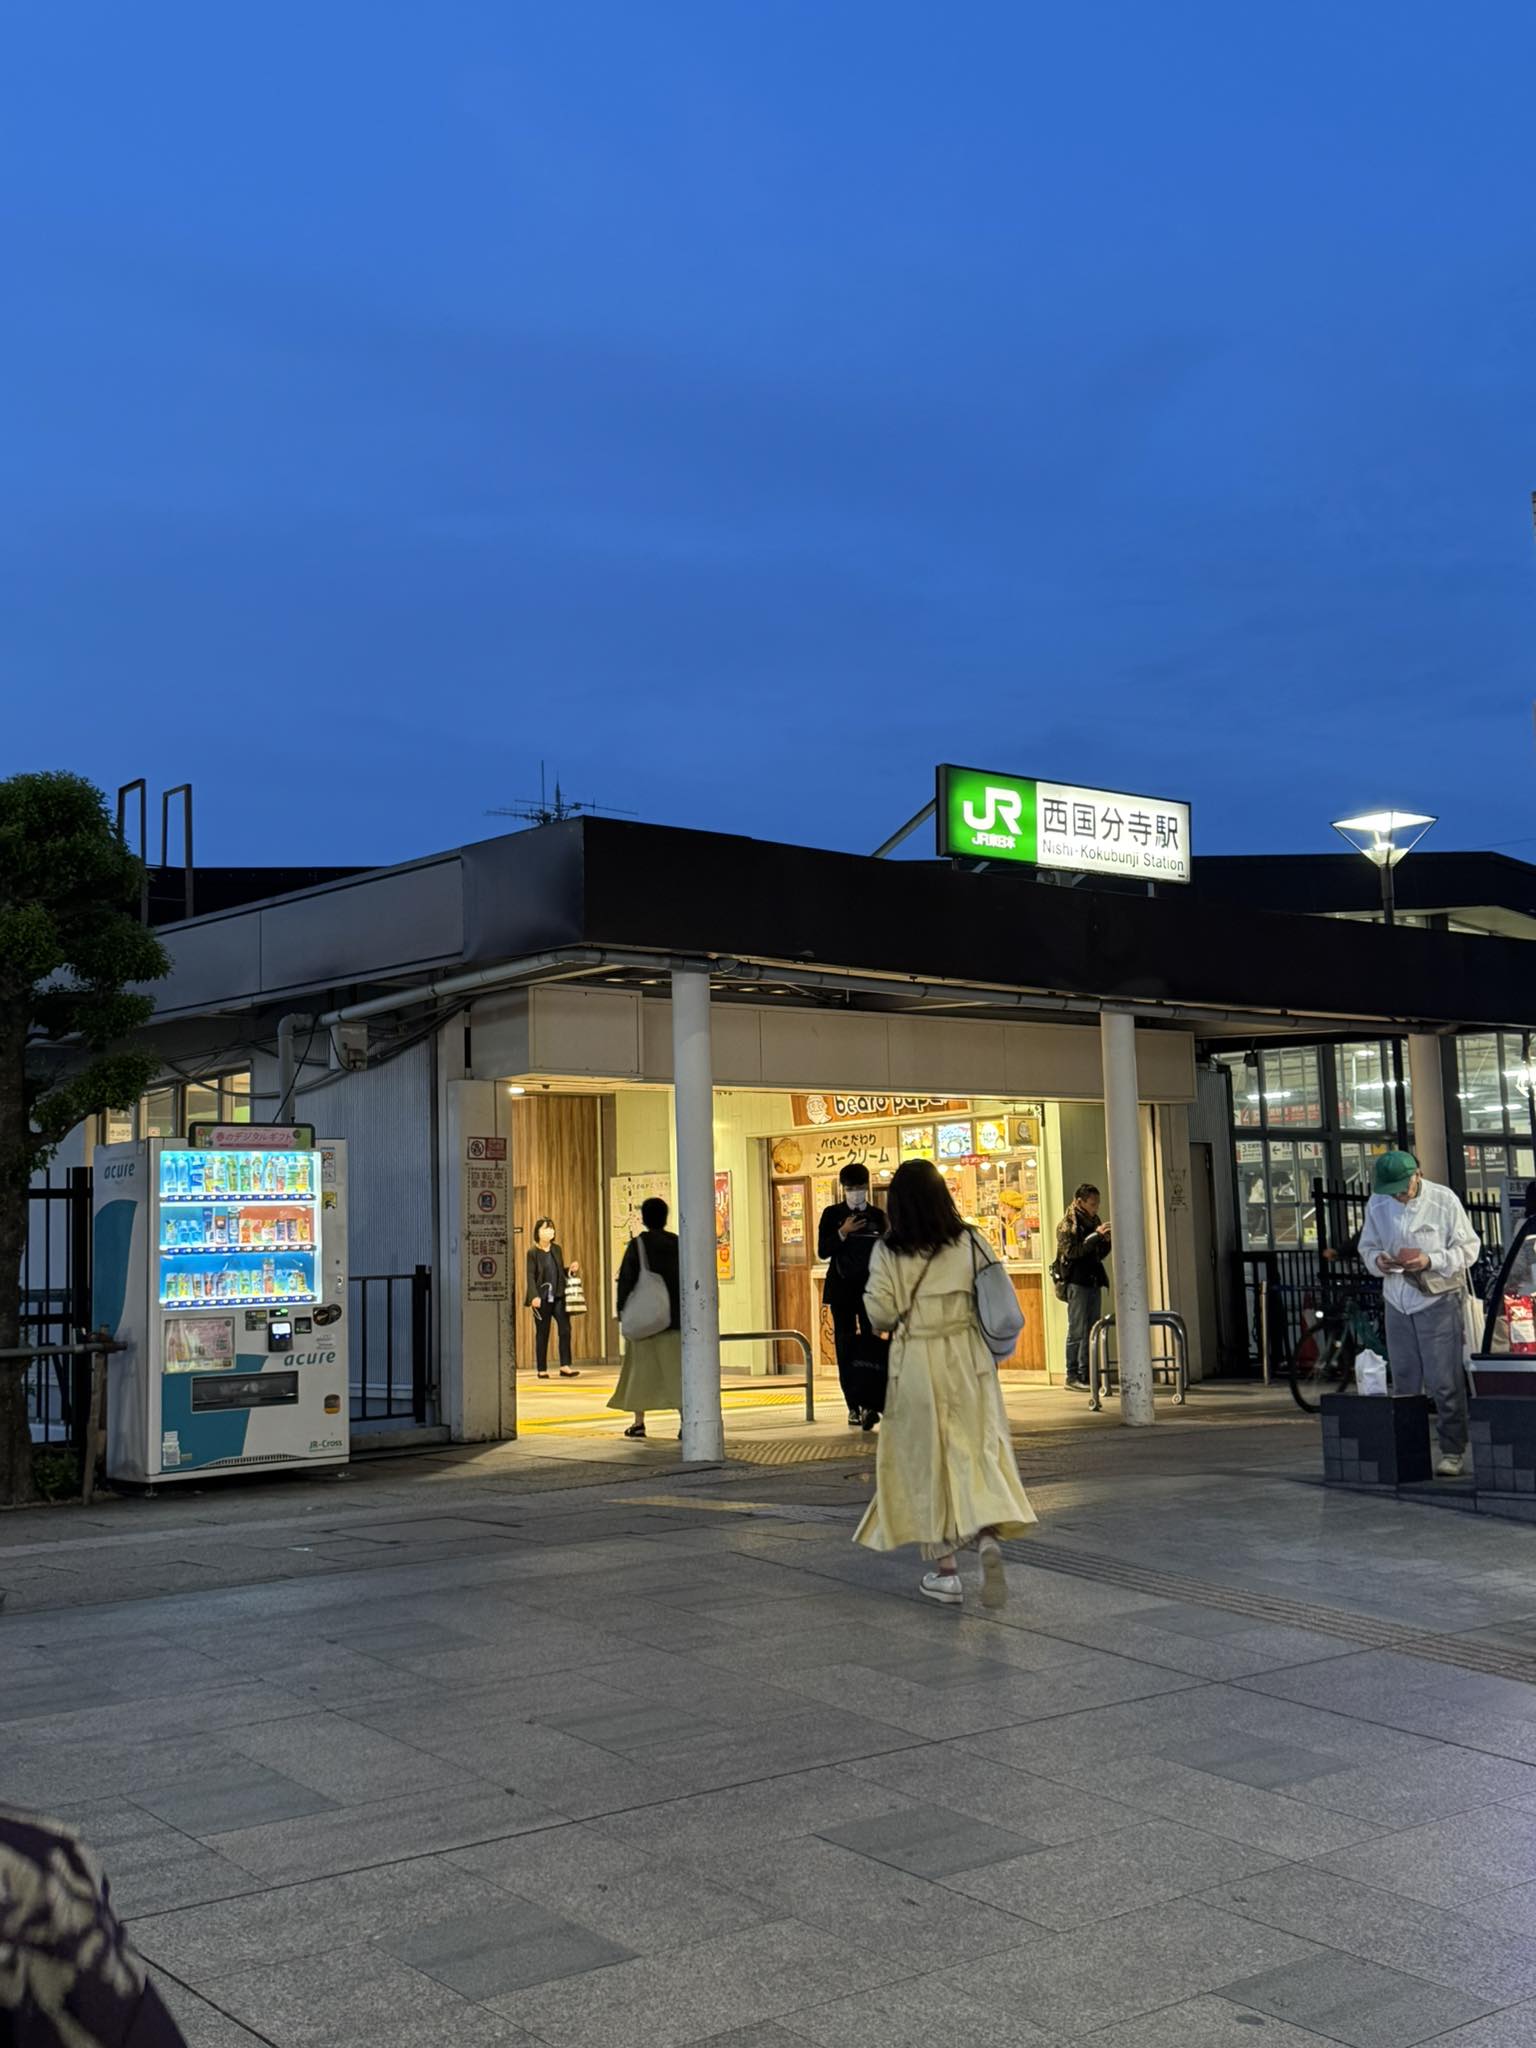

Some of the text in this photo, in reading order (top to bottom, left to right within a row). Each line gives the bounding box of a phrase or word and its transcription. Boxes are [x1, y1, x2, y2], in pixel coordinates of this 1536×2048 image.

[963, 786, 1022, 835] JR
[1043, 798, 1178, 850] 西国分寺駅
[1144, 853, 1185, 871] Station
[815, 1146, 890, 1168] シュークリーム
[104, 1163, 135, 1179] acure
[284, 1351, 336, 1366] acure
